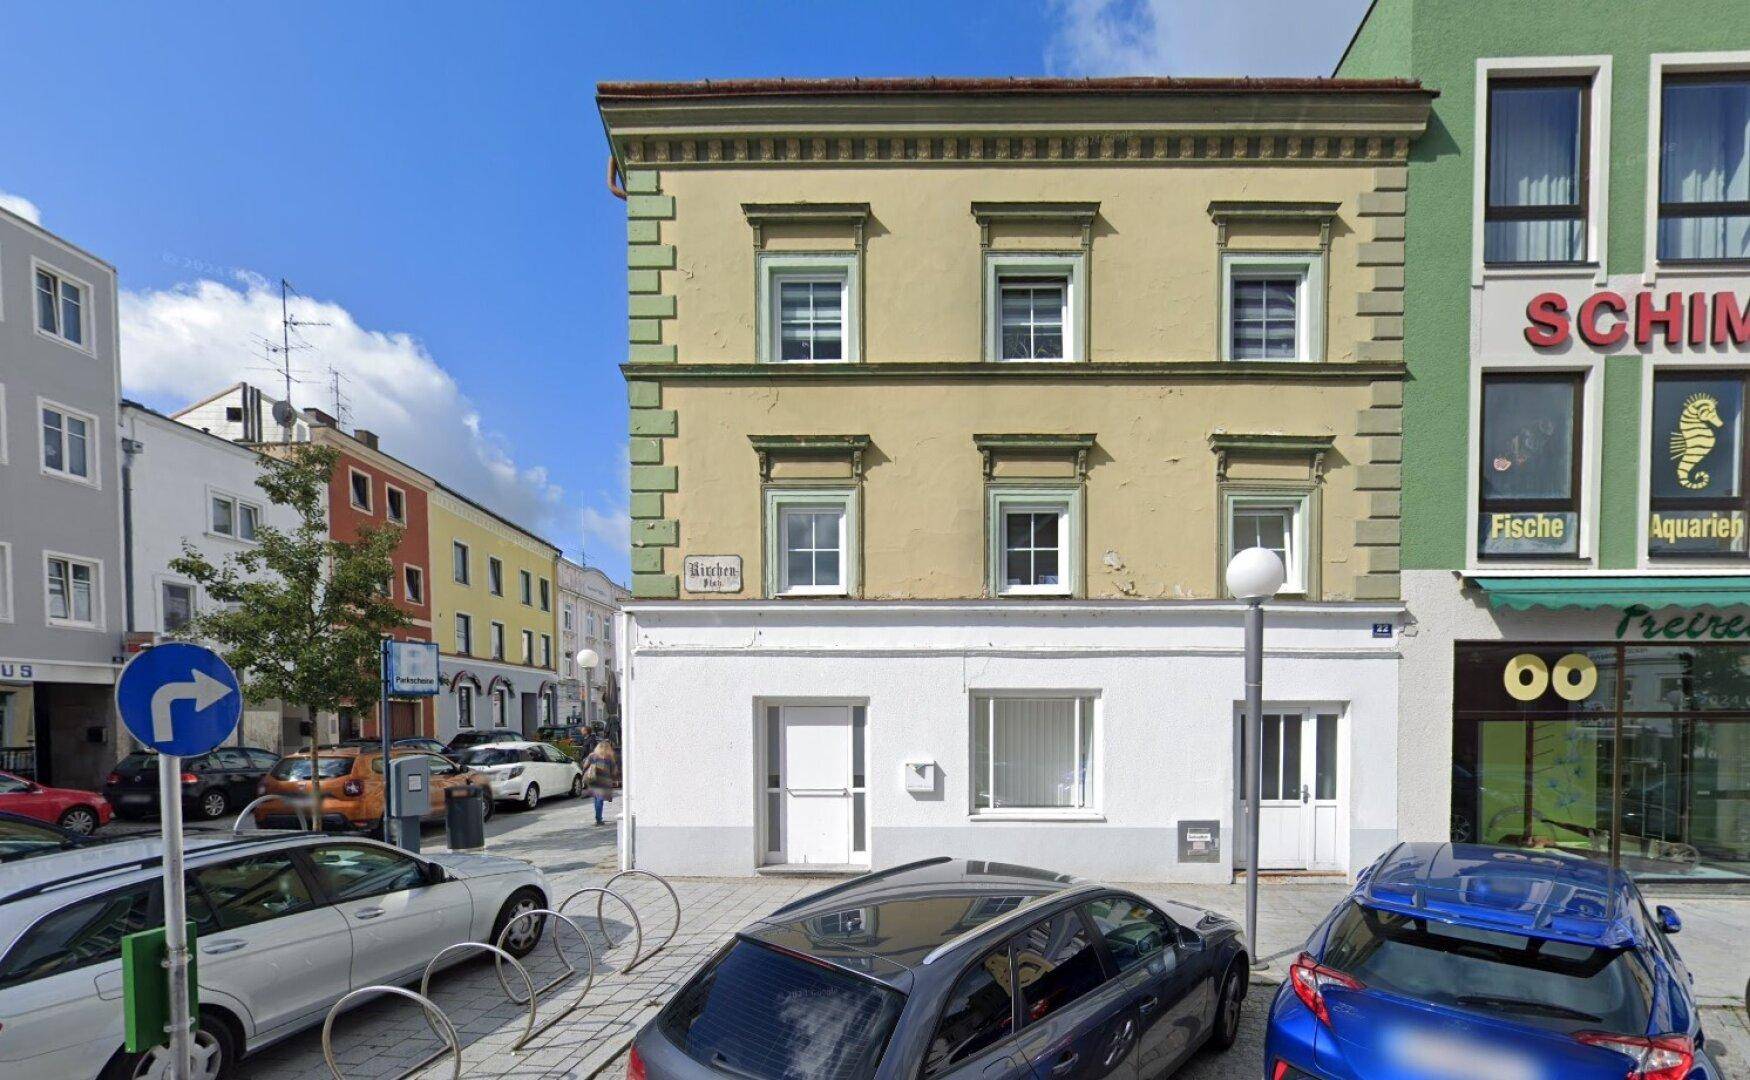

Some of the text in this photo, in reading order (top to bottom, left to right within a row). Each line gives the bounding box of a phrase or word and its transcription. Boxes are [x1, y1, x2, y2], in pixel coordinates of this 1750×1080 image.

[1491, 513, 1564, 539] Fische
[1651, 511, 1744, 544] Aquarien
[1376, 624, 1389, 633] 22
